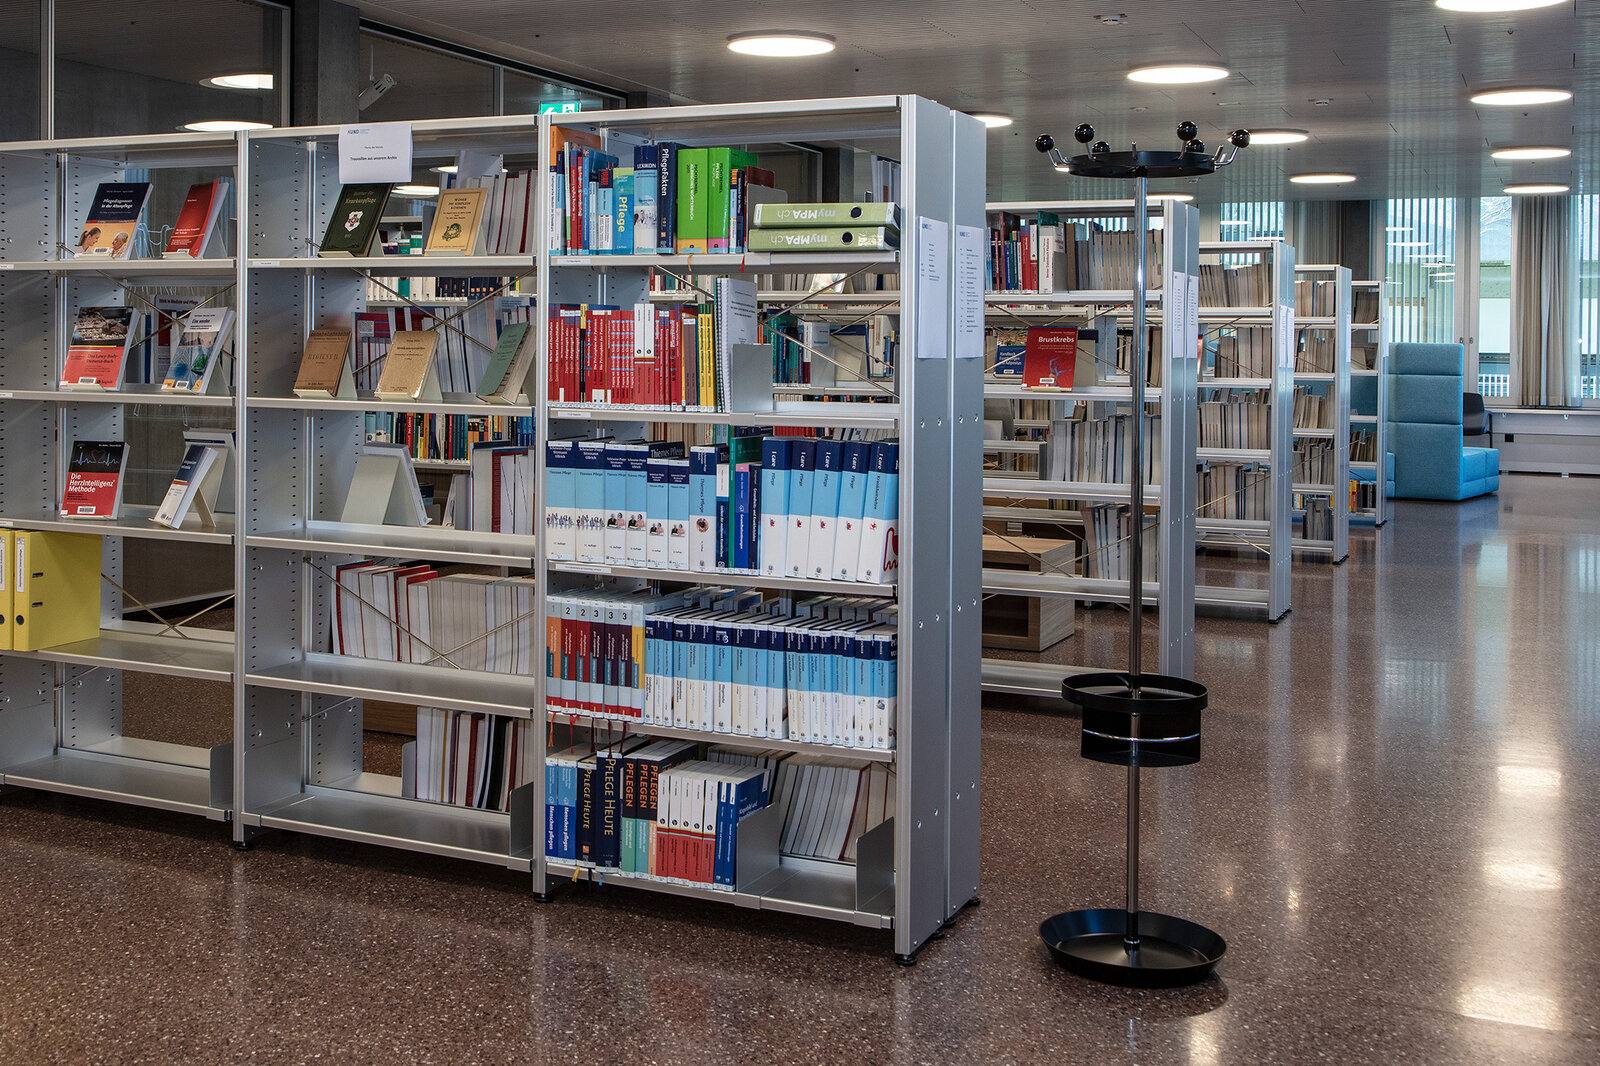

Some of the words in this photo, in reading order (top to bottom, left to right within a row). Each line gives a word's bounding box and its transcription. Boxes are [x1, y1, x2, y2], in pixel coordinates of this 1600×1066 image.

[660, 149, 669, 196] PflegeFakten
[617, 196, 628, 233] Pflege
[777, 208, 836, 219] myMPA.ch
[770, 234, 827, 245] myMPA.ch
[651, 449, 669, 458] Thiemes
[565, 607, 570, 615] 2
[594, 610, 599, 618] 3
[608, 611, 613, 619] 3
[622, 612, 627, 620] 3
[583, 769, 592, 798] PFLEGE
[604, 758, 617, 796] PFLEGE
[625, 762, 634, 807] PFLEGEN
[639, 764, 648, 808] PFLEGEN
[649, 765, 658, 810] PFLEGEN
[583, 800, 591, 829] HEUTE
[604, 799, 616, 836] HEUTE
